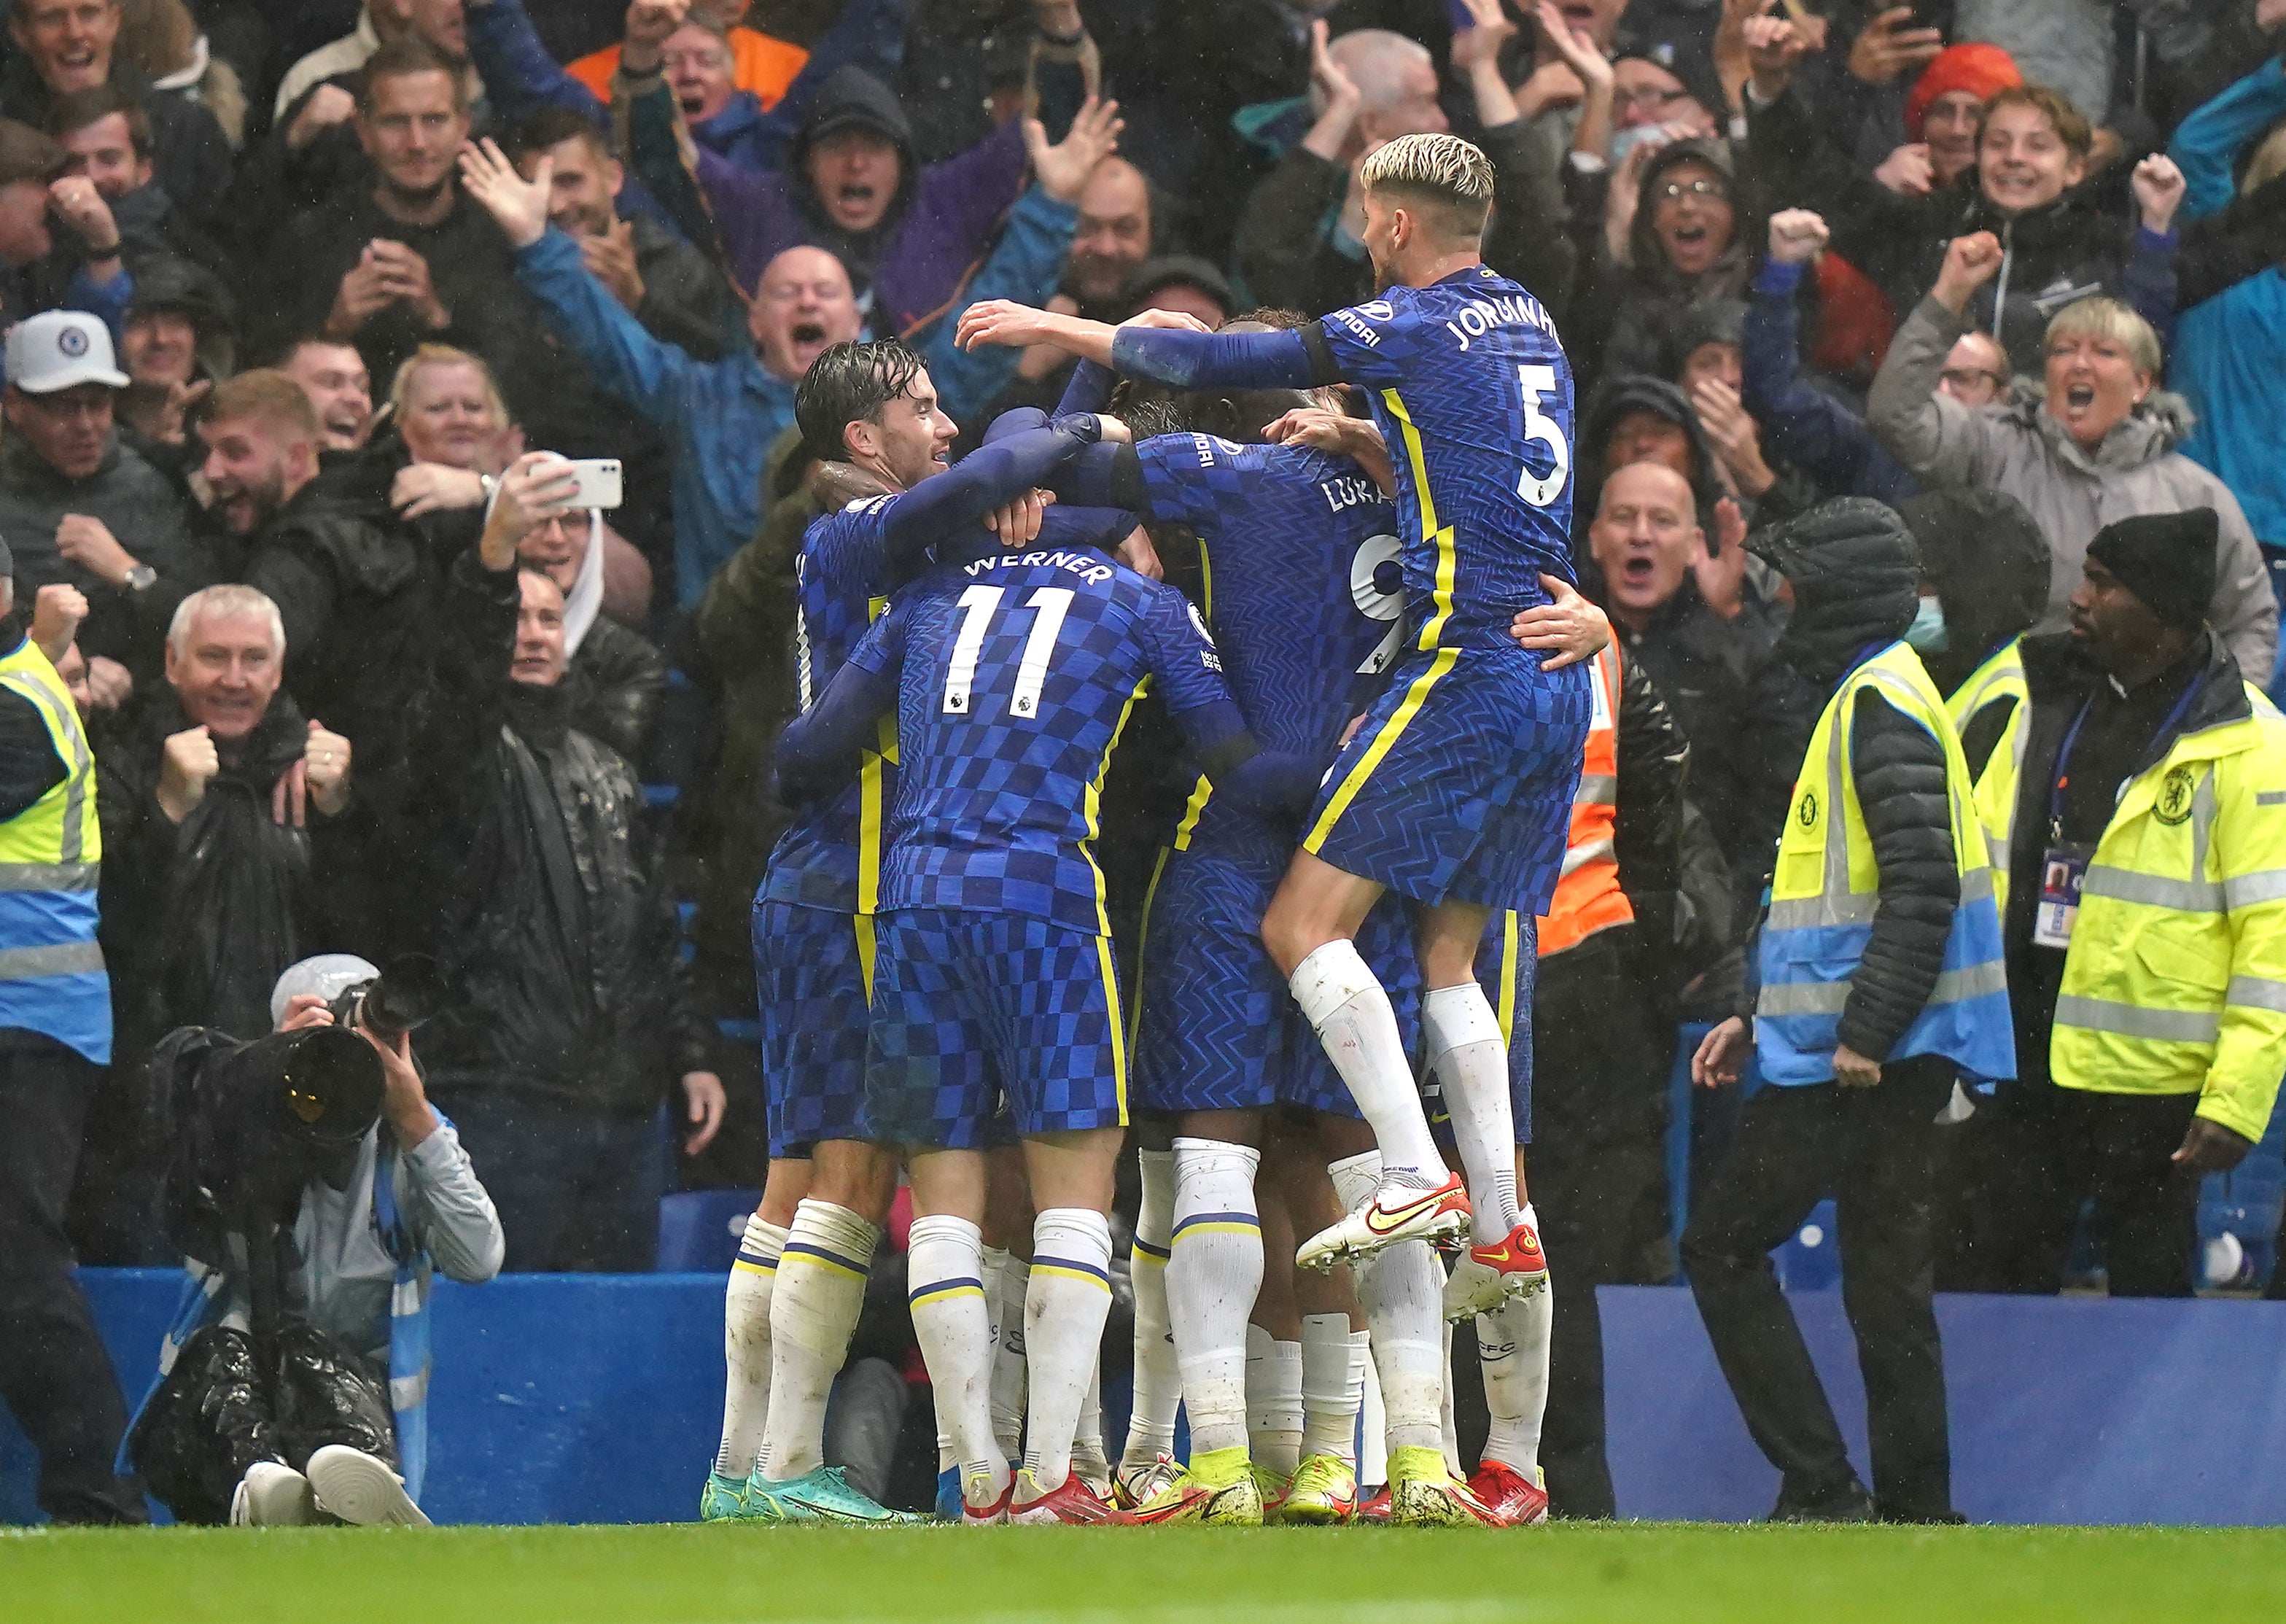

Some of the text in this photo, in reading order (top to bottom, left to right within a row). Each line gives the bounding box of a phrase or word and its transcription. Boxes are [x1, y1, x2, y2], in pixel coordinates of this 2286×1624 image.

[1321, 476, 1395, 513] LUKA
[1517, 365, 1568, 507] 5
[963, 551, 1113, 586] WERNER
[1350, 534, 1406, 675] 9
[942, 584, 1076, 720] 11
